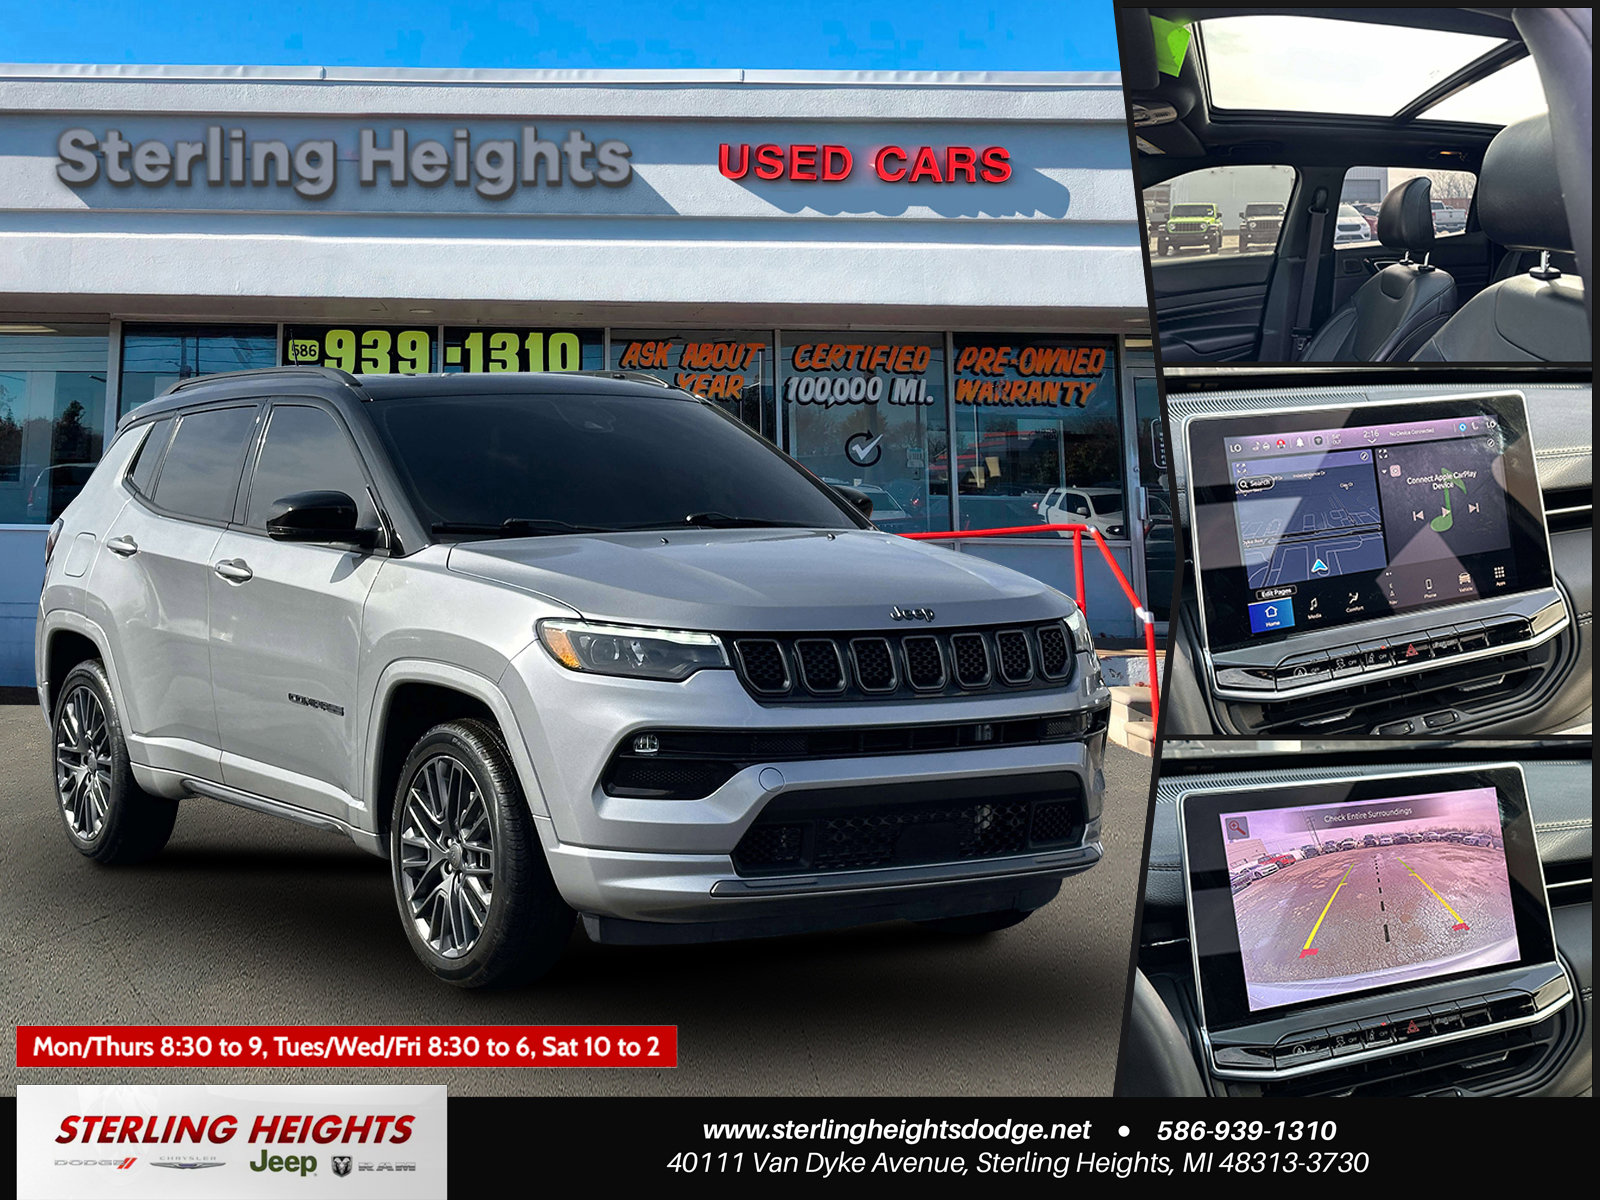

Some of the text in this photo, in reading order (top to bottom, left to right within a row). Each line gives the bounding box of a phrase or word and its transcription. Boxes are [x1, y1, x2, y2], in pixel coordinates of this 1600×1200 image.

[56, 126, 634, 199] Sterling Heights
[718, 143, 1012, 184] USED CARS
[291, 344, 317, 357] 586
[620, 341, 766, 372] ASK ABOUT
[793, 344, 932, 373] CERTIFIED
[956, 346, 1106, 376] PRE-OWNED
[675, 372, 745, 402] YEAR
[784, 376, 934, 408] 100,000 MI.
[954, 379, 1097, 407] WARRANTY
[1363, 429, 1380, 439] 2:16
[1249, 478, 1271, 488] Search
[1406, 470, 1477, 485] Connect Apple CarPlay
[1432, 482, 1454, 490] Device
[1274, 587, 1292, 597] Pages
[889, 605, 936, 623] Jeep
[1265, 620, 1281, 628] Home
[1323, 807, 1413, 823] Check Entire Surroundings
